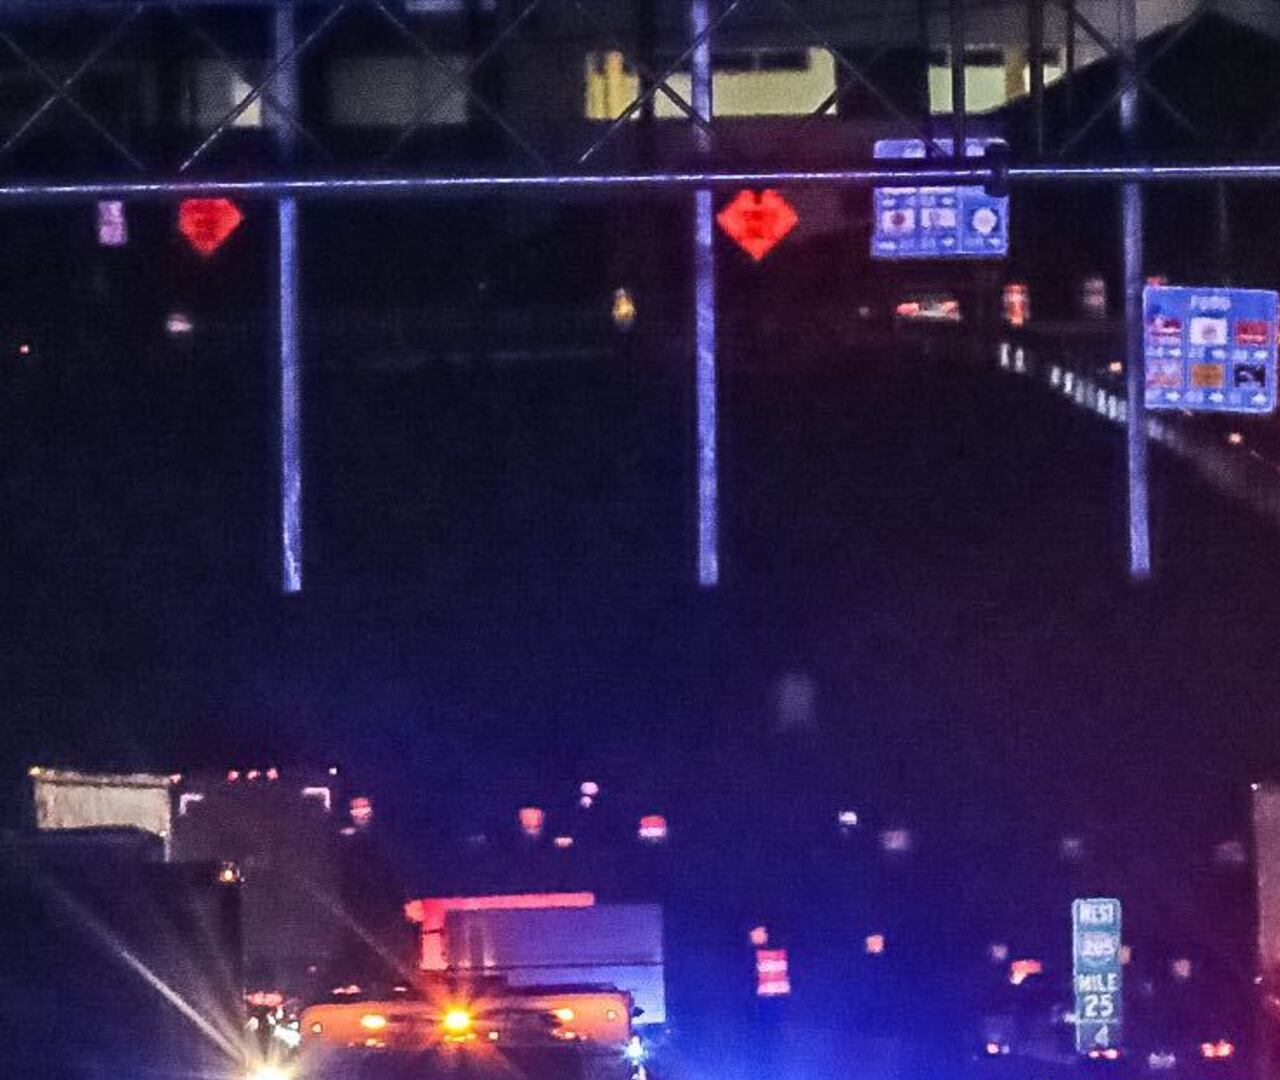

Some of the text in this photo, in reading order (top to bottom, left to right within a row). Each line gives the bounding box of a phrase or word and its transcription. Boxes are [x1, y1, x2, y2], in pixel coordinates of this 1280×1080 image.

[1079, 904, 1115, 923] WEST
[1078, 973, 1119, 993] MILE
[1083, 994, 1115, 1018] 25
